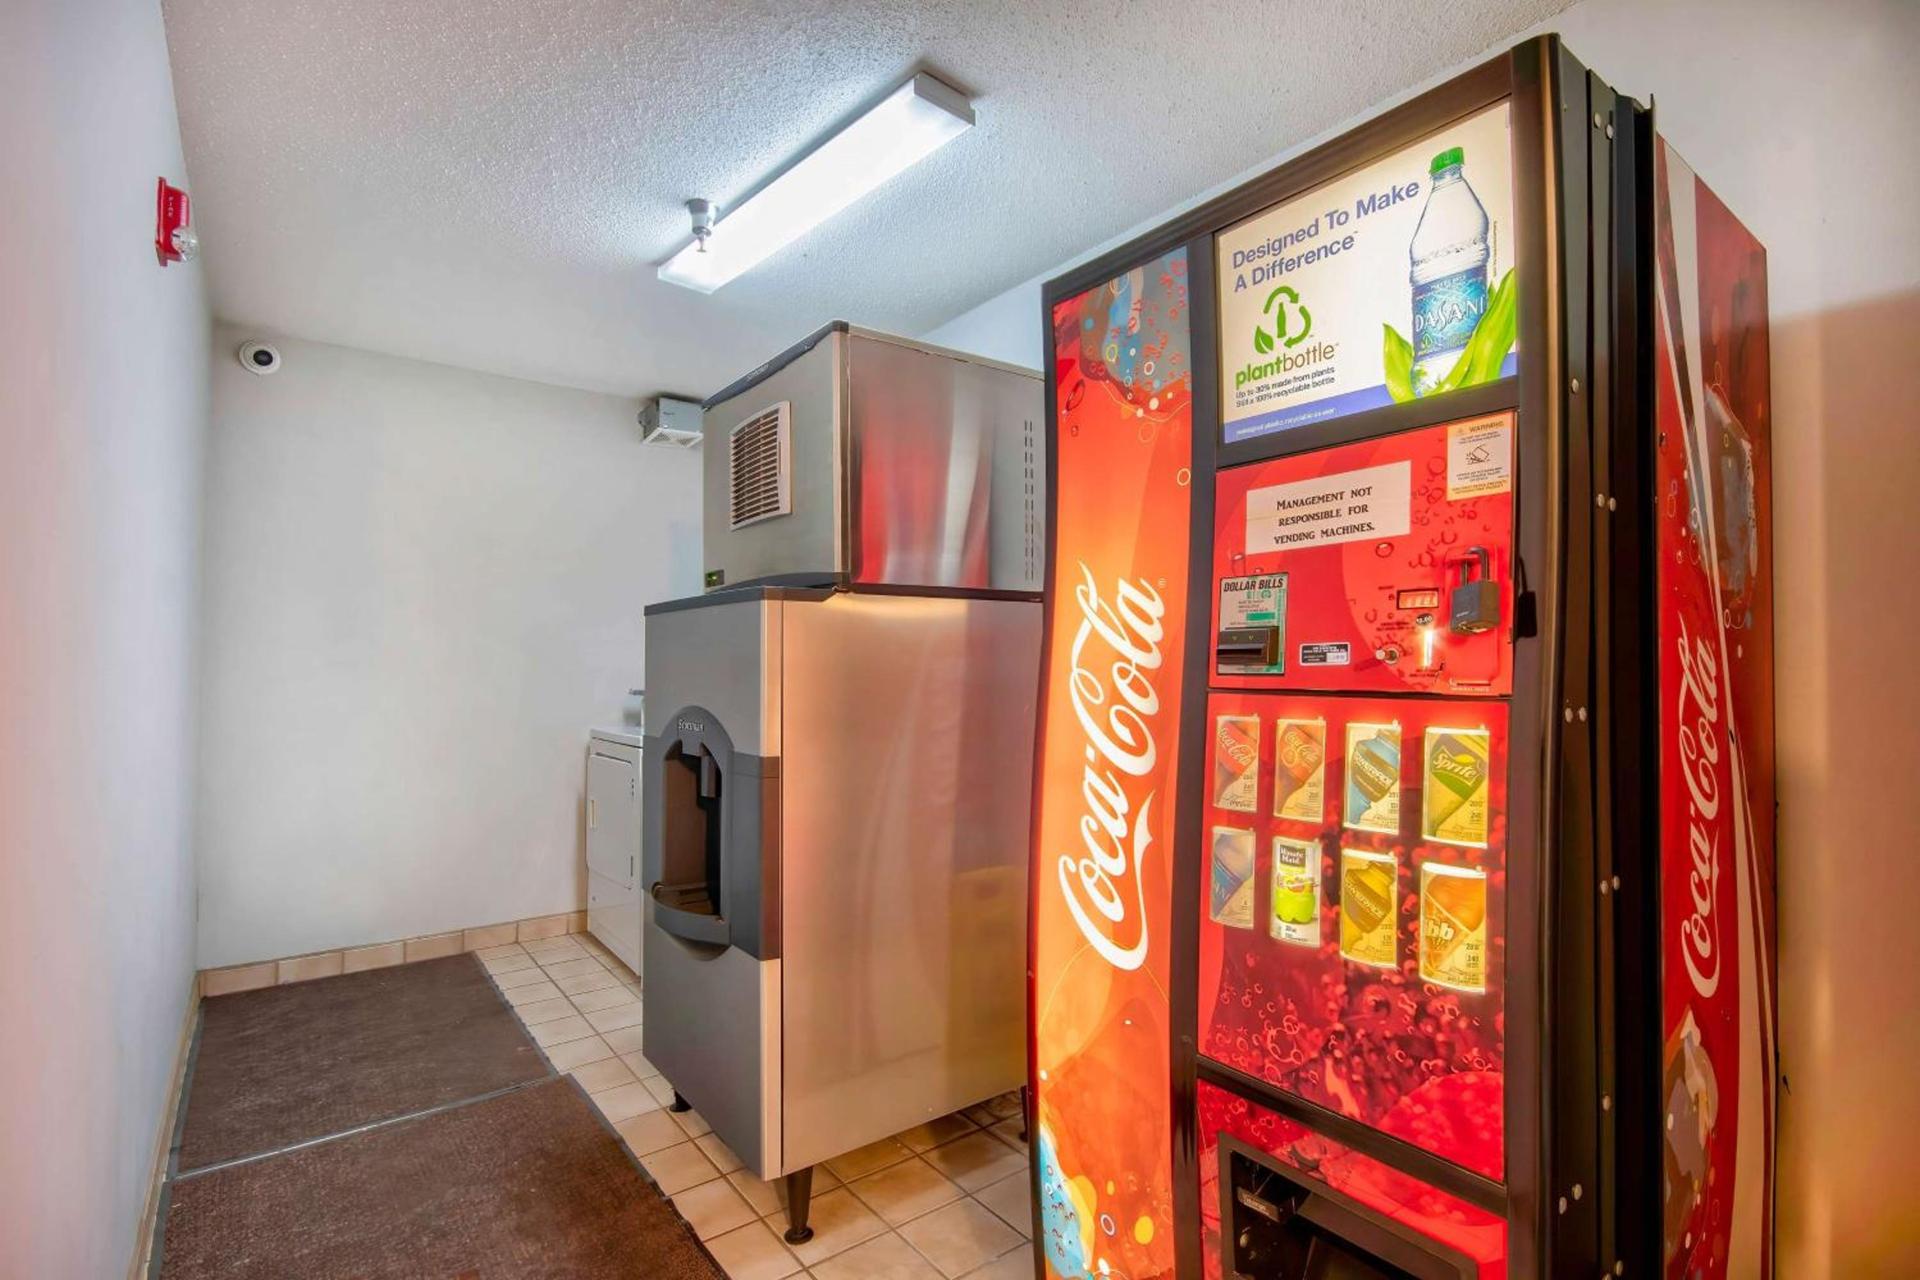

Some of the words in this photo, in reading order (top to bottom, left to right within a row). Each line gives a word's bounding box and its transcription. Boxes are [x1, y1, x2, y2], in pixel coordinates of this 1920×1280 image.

[1233, 218, 1319, 269] Designed
[1325, 209, 1349, 230] To
[1356, 182, 1419, 219] Make
[1234, 274, 1247, 292] A
[1252, 234, 1355, 286] Difference
[1415, 297, 1484, 332] DASANI
[1235, 342, 1335, 390] plantbottle
[1272, 378, 1291, 390] made
[1293, 373, 1310, 383] from
[1311, 366, 1335, 380] plants
[1311, 376, 1335, 388] bottle
[1276, 491, 1345, 511] MANAGEMENT
[1350, 486, 1373, 498] NOT
[1278, 508, 1342, 527] RESPONSIBLE
[1348, 504, 1369, 515] FOR
[1274, 531, 1316, 544] VENDING
[1320, 522, 1375, 538] MACHINES.
[1223, 580, 1256, 592] DOLLAR
[1258, 578, 1283, 590] BILLS
[1058, 560, 1165, 970] Coca-Cola
[1432, 752, 1477, 778] Sprite
[1678, 609, 1720, 998] Coca-Cola
